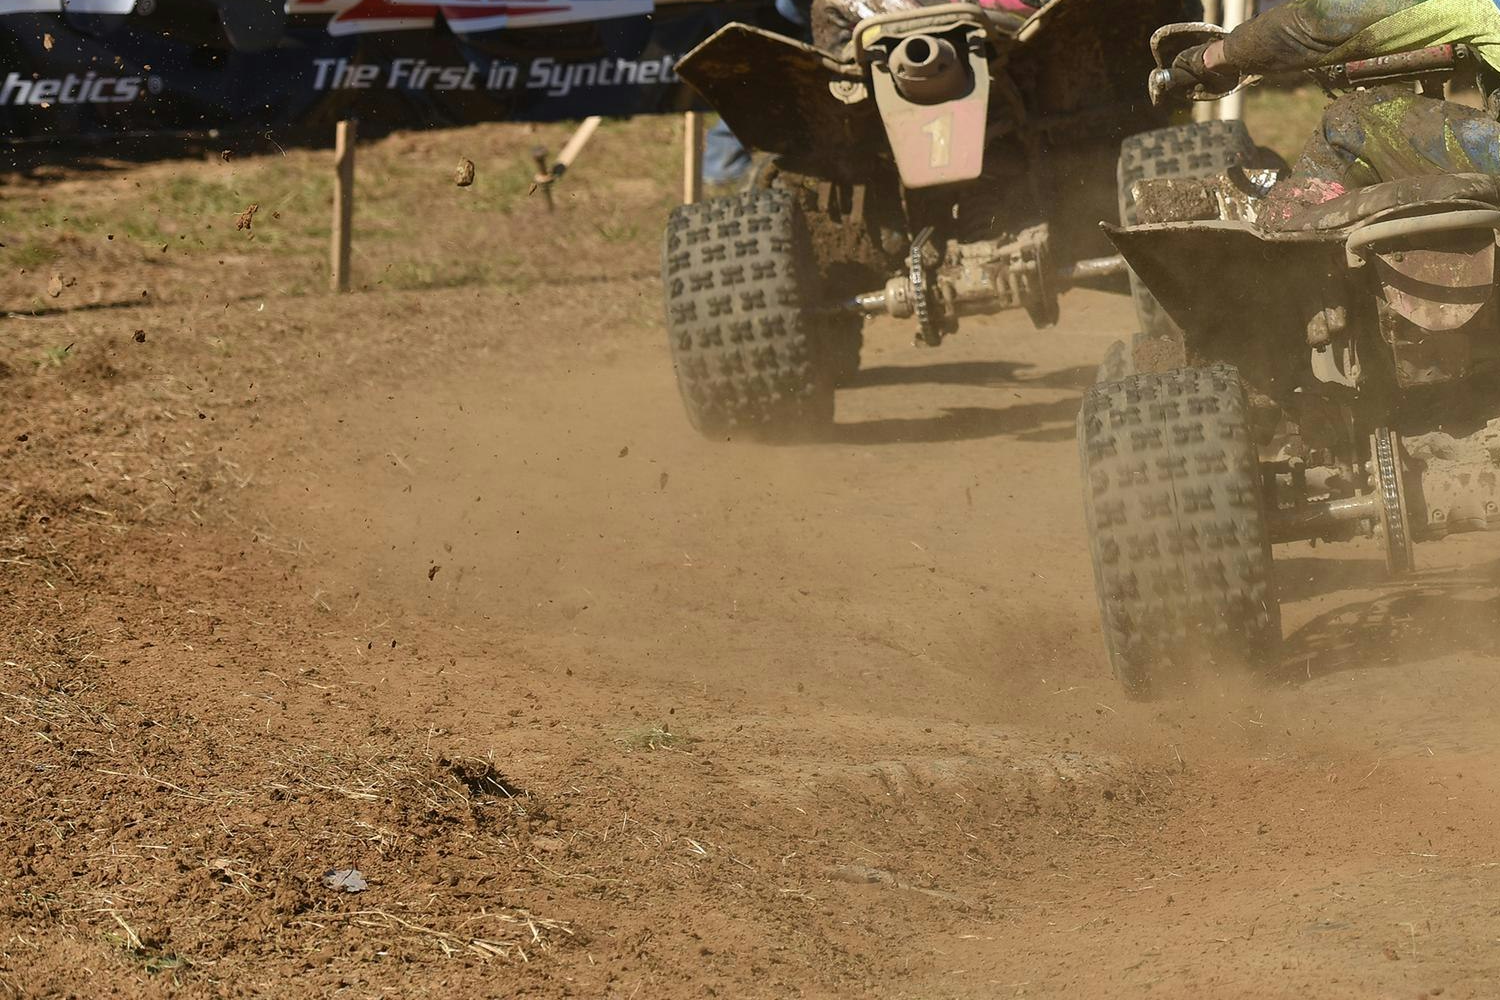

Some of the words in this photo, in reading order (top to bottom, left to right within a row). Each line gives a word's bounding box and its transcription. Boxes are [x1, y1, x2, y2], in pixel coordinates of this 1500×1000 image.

[0, 70, 142, 106] hetics
[313, 57, 379, 91] The
[386, 56, 480, 92] First
[485, 58, 518, 90] in
[920, 111, 954, 169] 1
